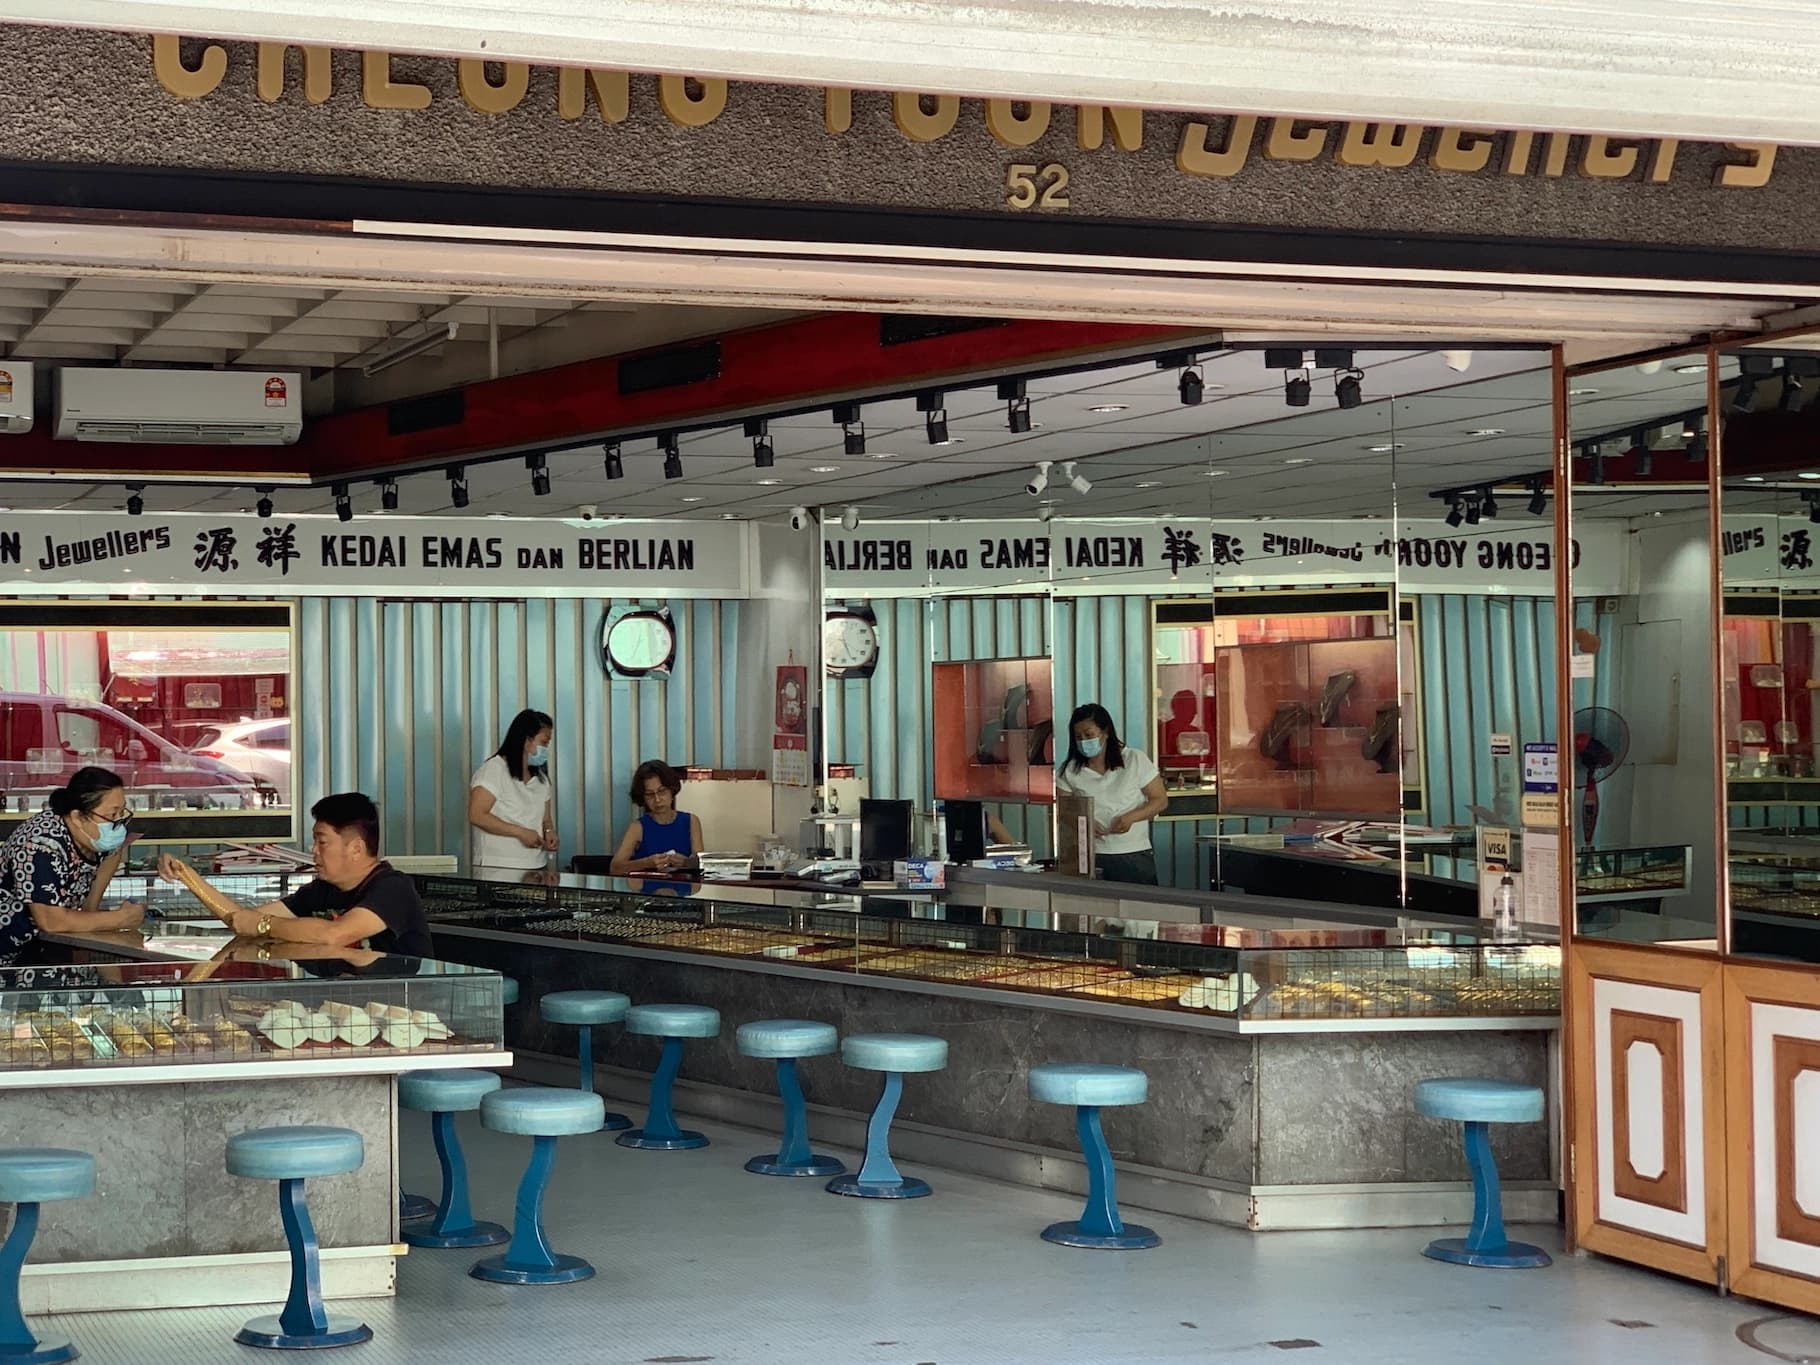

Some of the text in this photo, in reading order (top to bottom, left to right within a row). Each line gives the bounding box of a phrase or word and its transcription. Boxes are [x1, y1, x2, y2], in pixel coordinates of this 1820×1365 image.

[1007, 164, 1070, 209] 52
[39, 527, 170, 570] Jewellers
[321, 536, 406, 567] KEDAI
[422, 537, 502, 568] EMAS
[517, 548, 563, 569] DAN
[578, 539, 694, 570] BERLIAN
[1487, 842, 1507, 855] VISA
